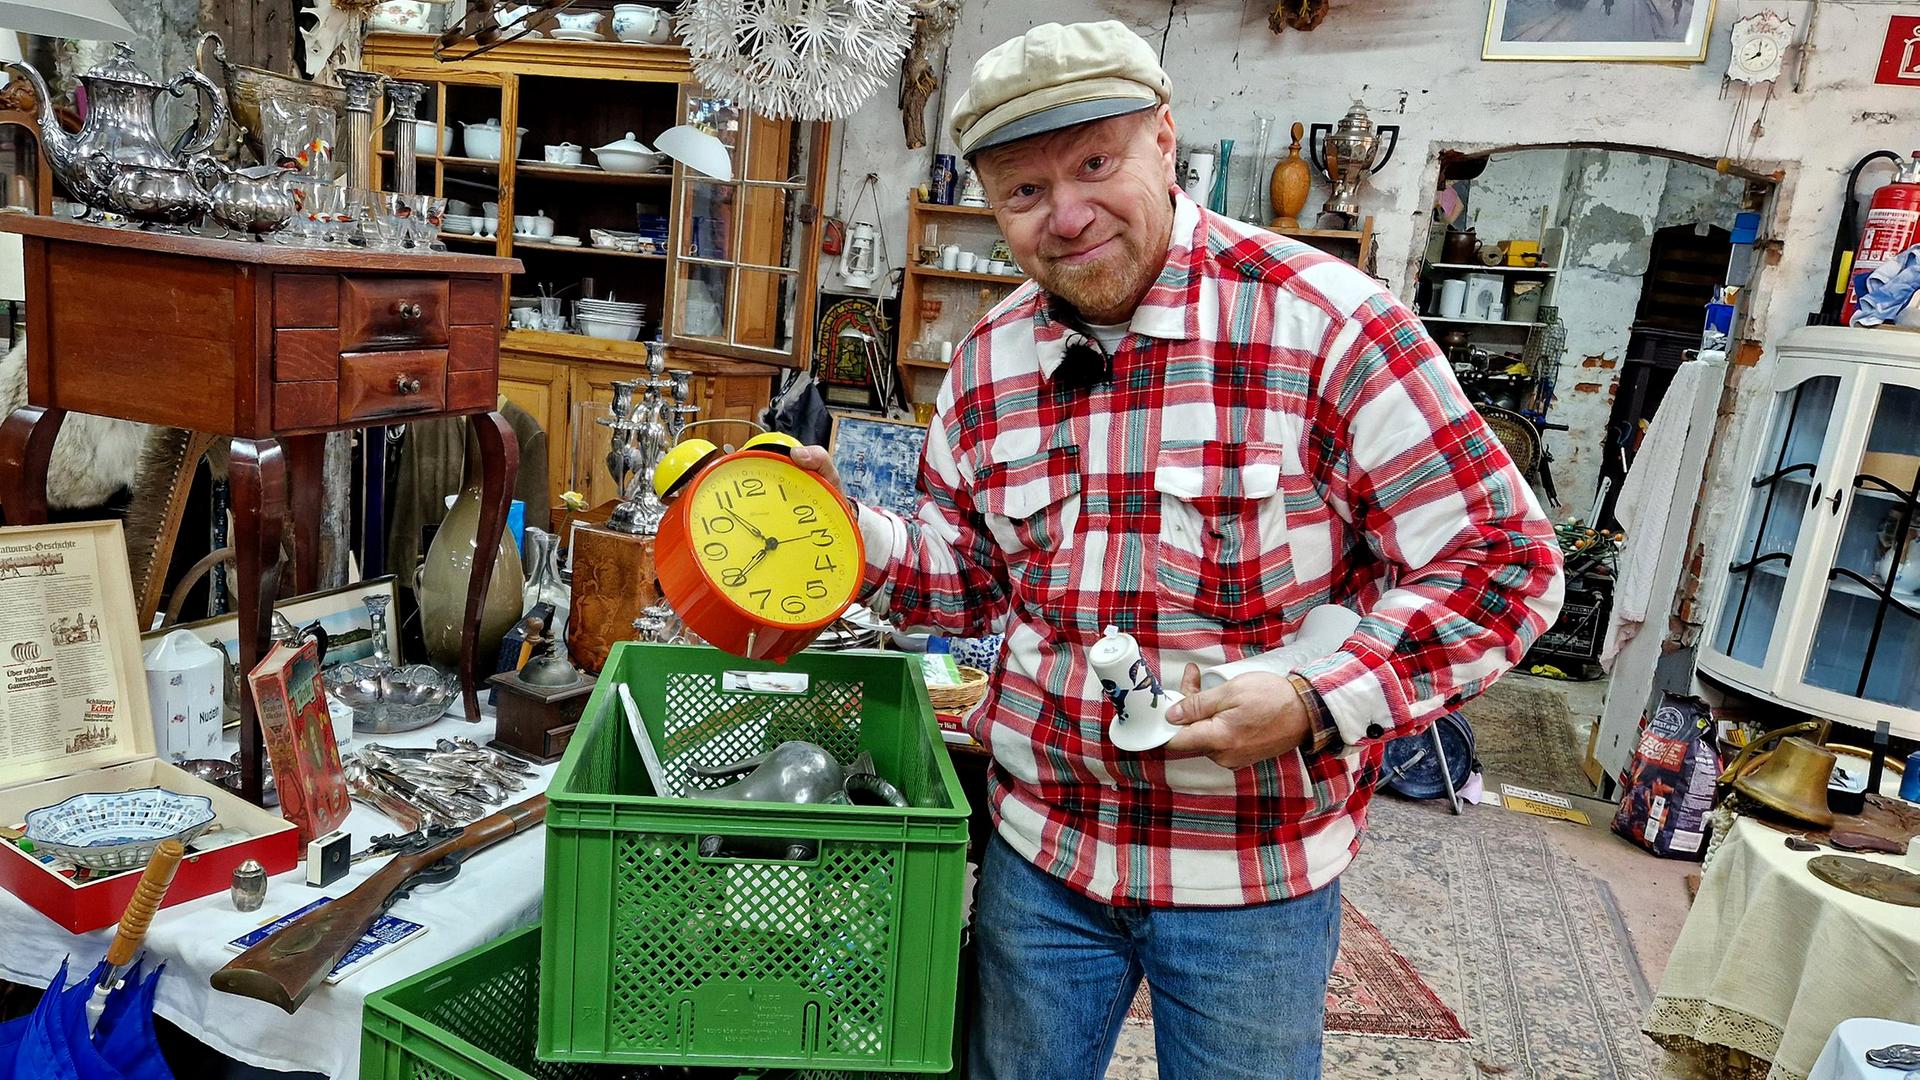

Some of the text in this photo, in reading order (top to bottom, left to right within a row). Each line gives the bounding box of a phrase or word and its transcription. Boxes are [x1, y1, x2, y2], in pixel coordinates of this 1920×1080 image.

[733, 478, 767, 498] 12
[778, 484, 788, 502] 1
[715, 491, 734, 510] 11
[793, 505, 818, 525] 2
[701, 516, 735, 535] 10
[810, 528, 834, 547] 3
[703, 542, 729, 562] 9
[814, 554, 837, 573] 4
[721, 567, 748, 587] 8
[749, 588, 772, 610] 7
[805, 579, 828, 600] 5
[780, 595, 806, 615] 6
